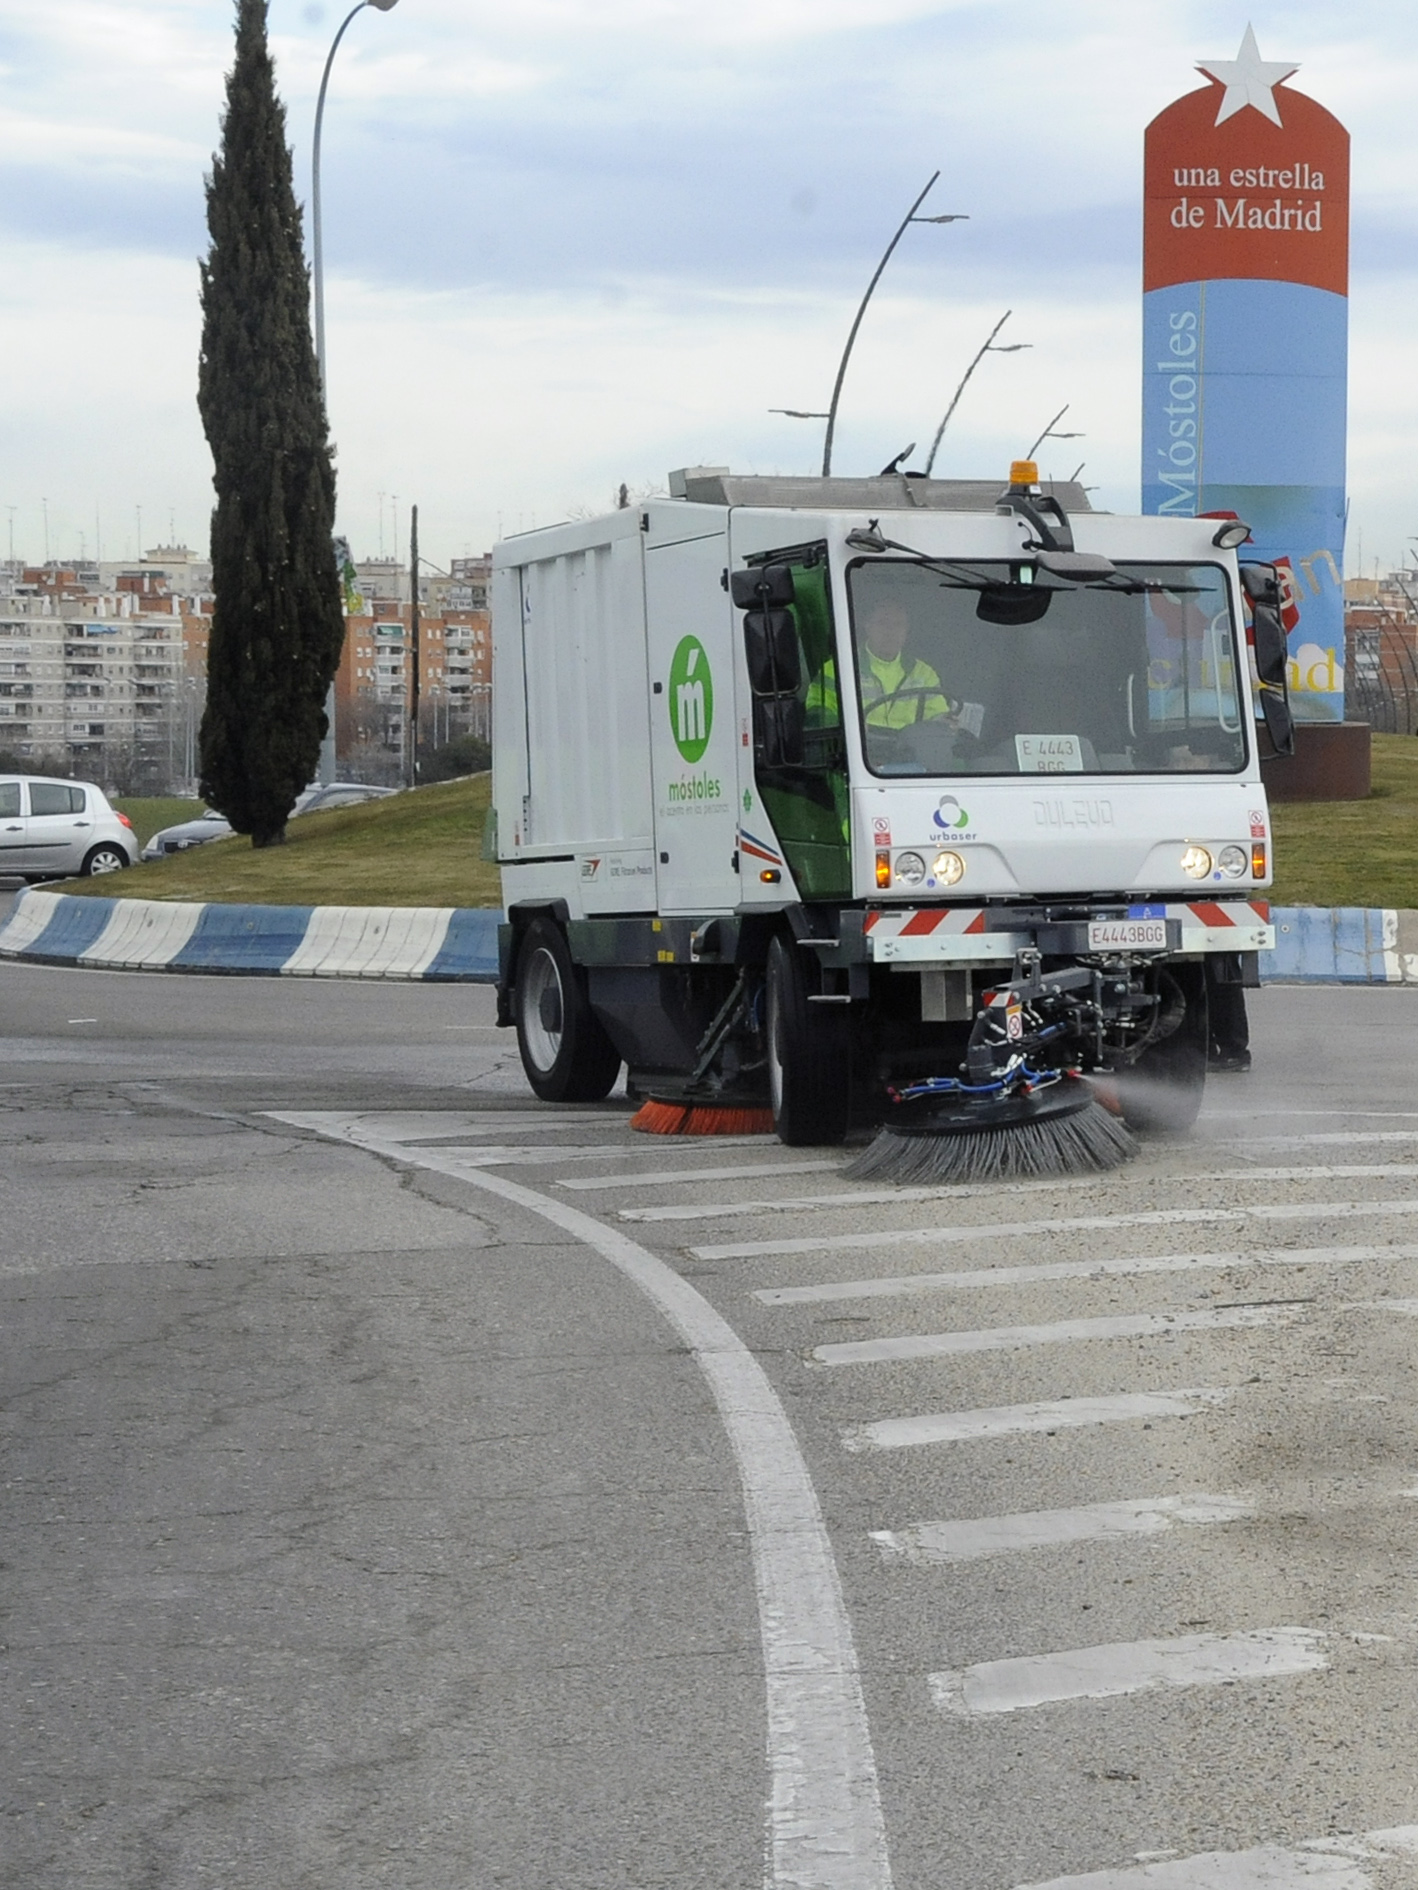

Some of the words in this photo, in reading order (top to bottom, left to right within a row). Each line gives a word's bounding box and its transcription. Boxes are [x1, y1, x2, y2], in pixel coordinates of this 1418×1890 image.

[1173, 167, 1221, 187] una
[1229, 163, 1325, 190] estrella
[1170, 197, 1205, 228] de
[1214, 198, 1322, 232] Madrid
[1157, 311, 1198, 516] Móstoles
[1023, 740, 1032, 755] E
[1039, 741, 1074, 756] 4443
[669, 770, 721, 801] móstoles
[929, 831, 978, 841] urbaser
[1092, 926, 1163, 944] E4443BGG
